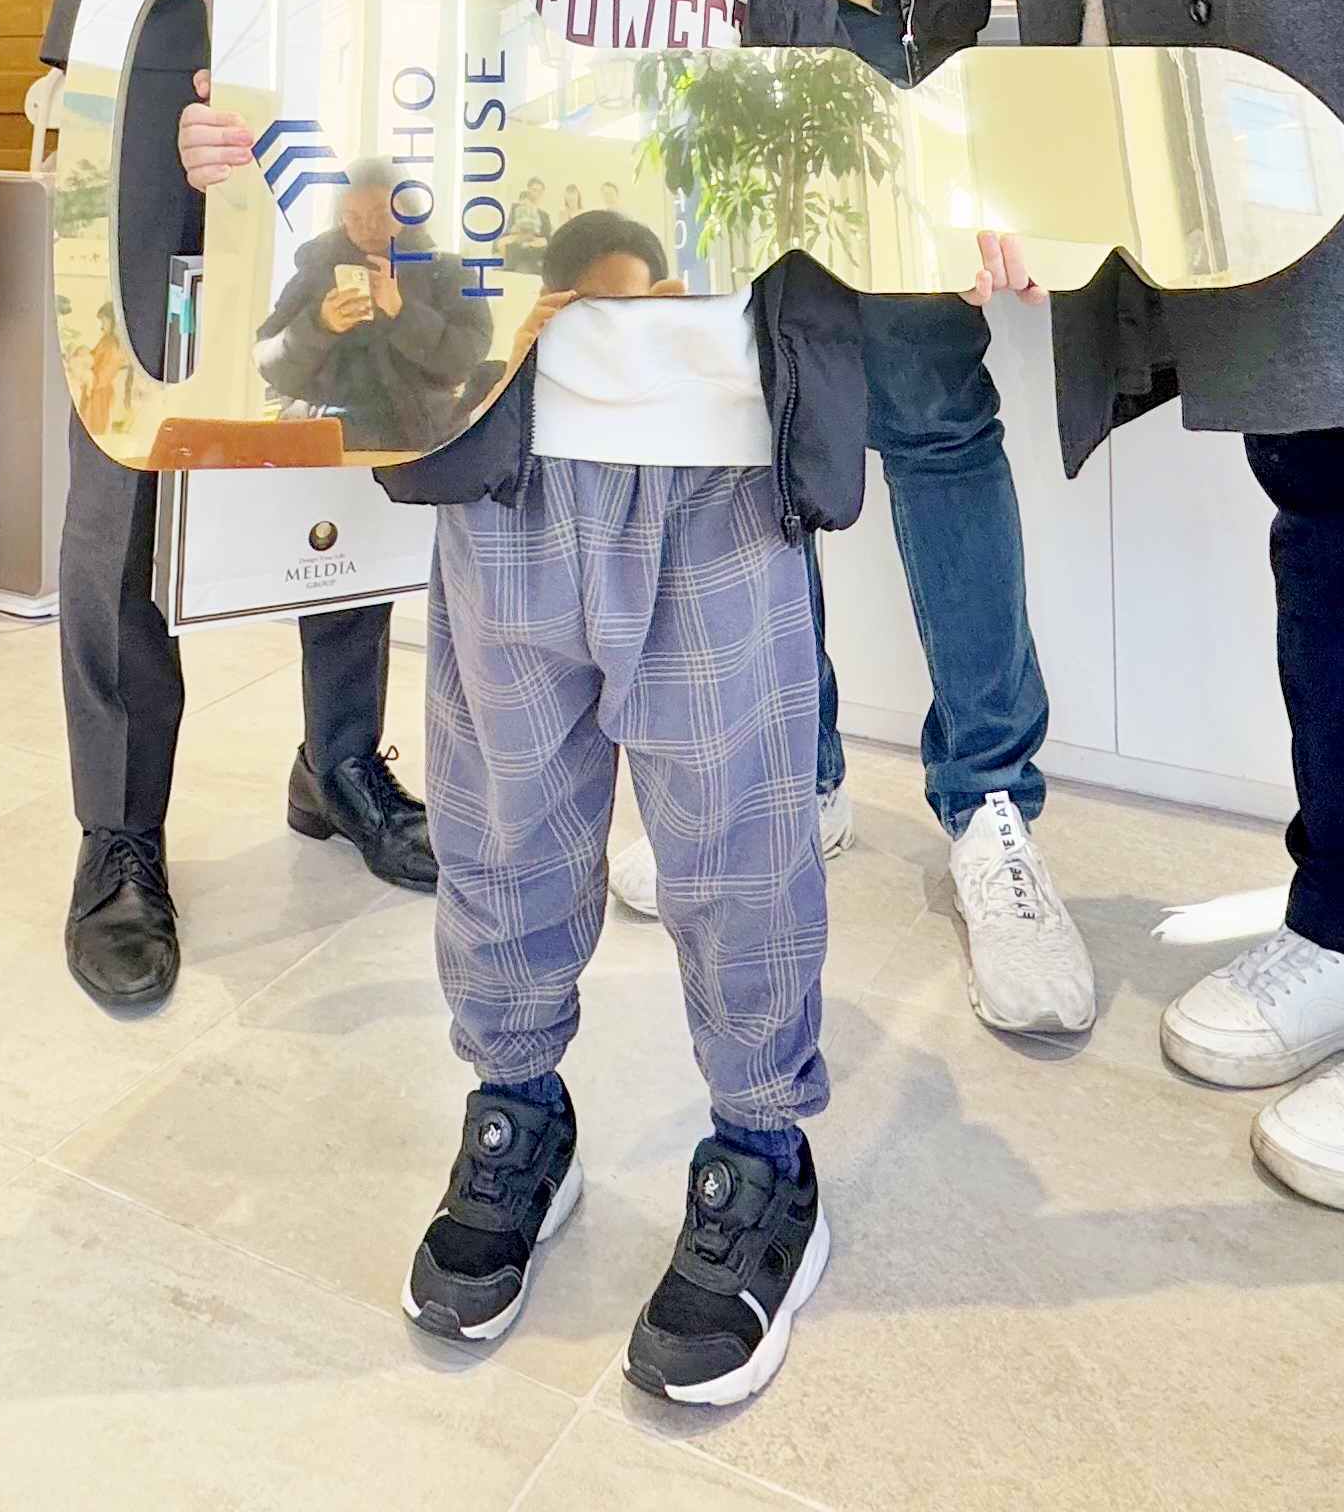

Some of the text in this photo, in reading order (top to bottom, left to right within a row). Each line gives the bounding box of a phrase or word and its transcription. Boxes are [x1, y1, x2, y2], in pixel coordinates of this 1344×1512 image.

[390, 66, 436, 280] TOHO
[461, 49, 507, 297] HOUSE
[284, 560, 358, 583] MELDIA
